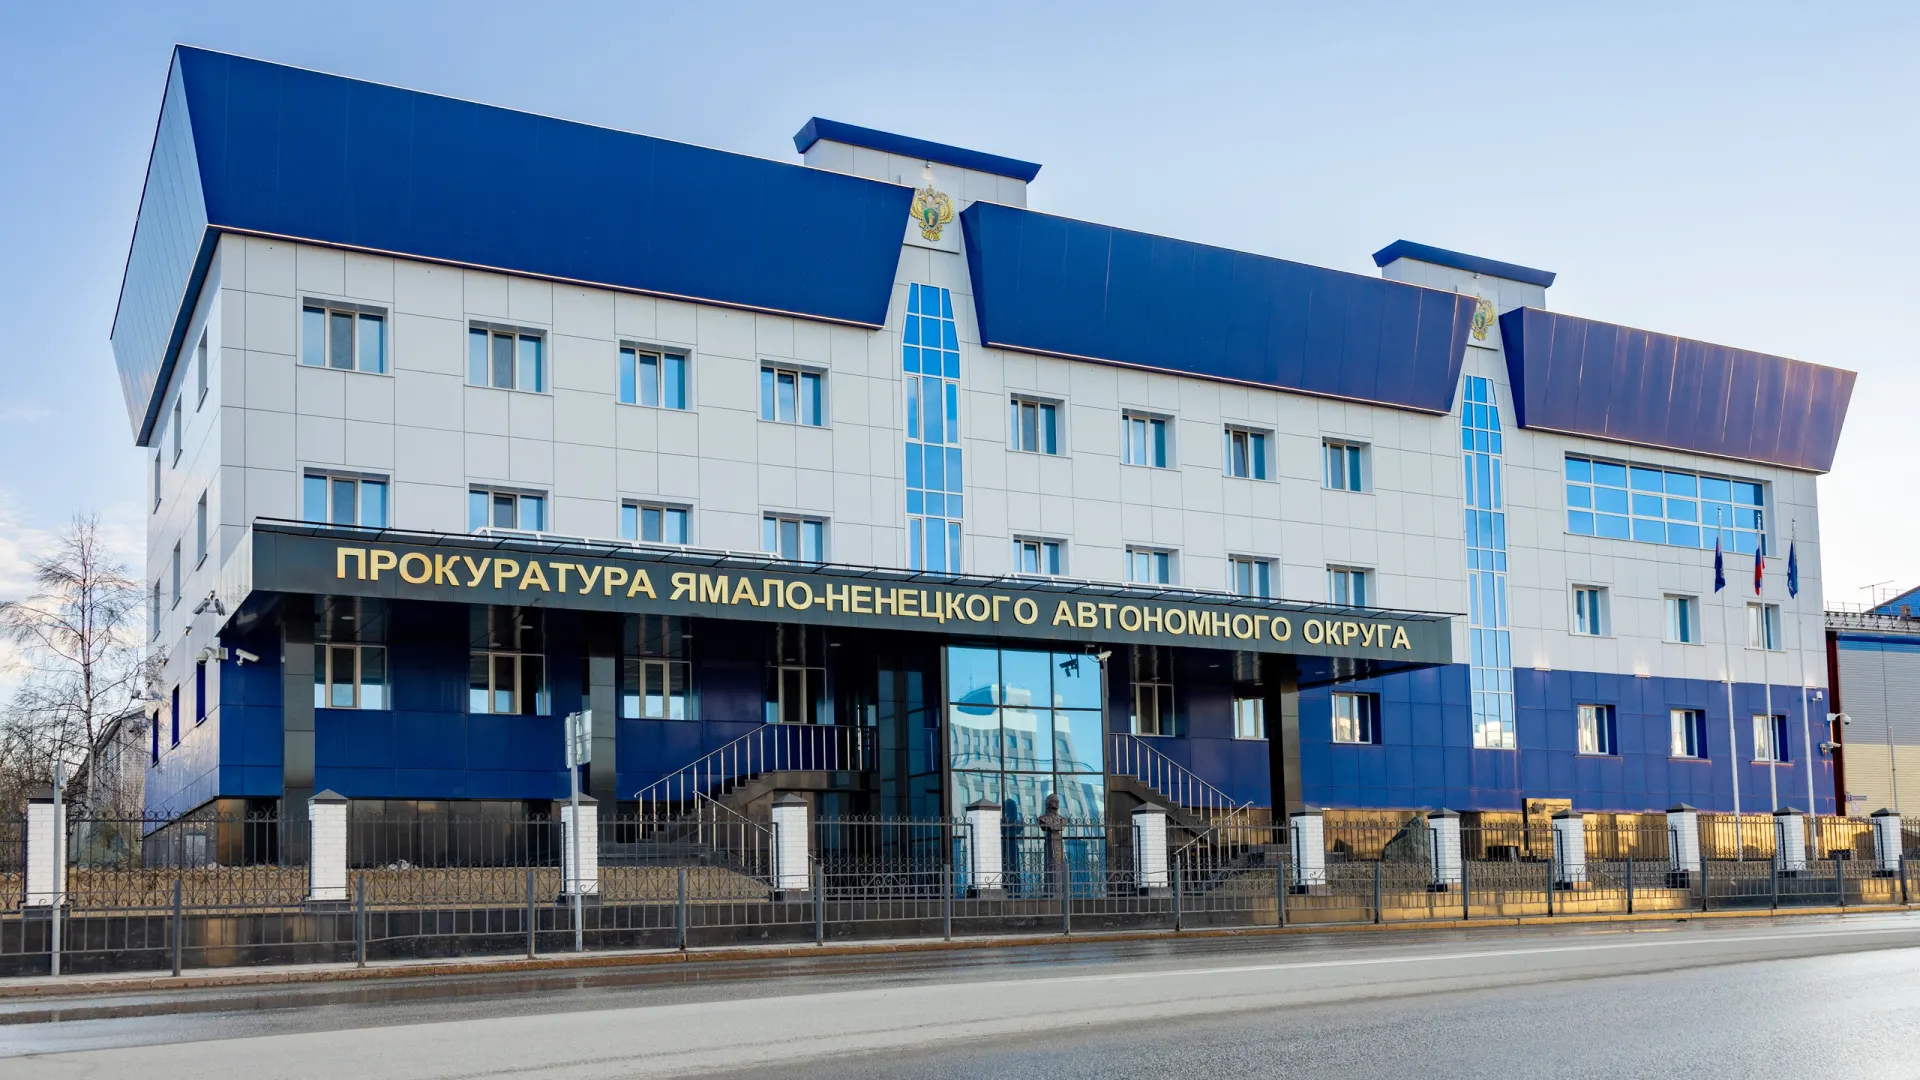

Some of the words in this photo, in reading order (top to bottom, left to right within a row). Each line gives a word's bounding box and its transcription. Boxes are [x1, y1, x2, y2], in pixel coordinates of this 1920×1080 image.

[336, 547, 657, 599] ПРОКУРАТУРА
[670, 572, 1039, 625] ЯМАЛО-НЕНЕЦКОГО
[1052, 600, 1293, 642] АВТОНОМНОГО
[1303, 620, 1412, 649] ОКРУГА
